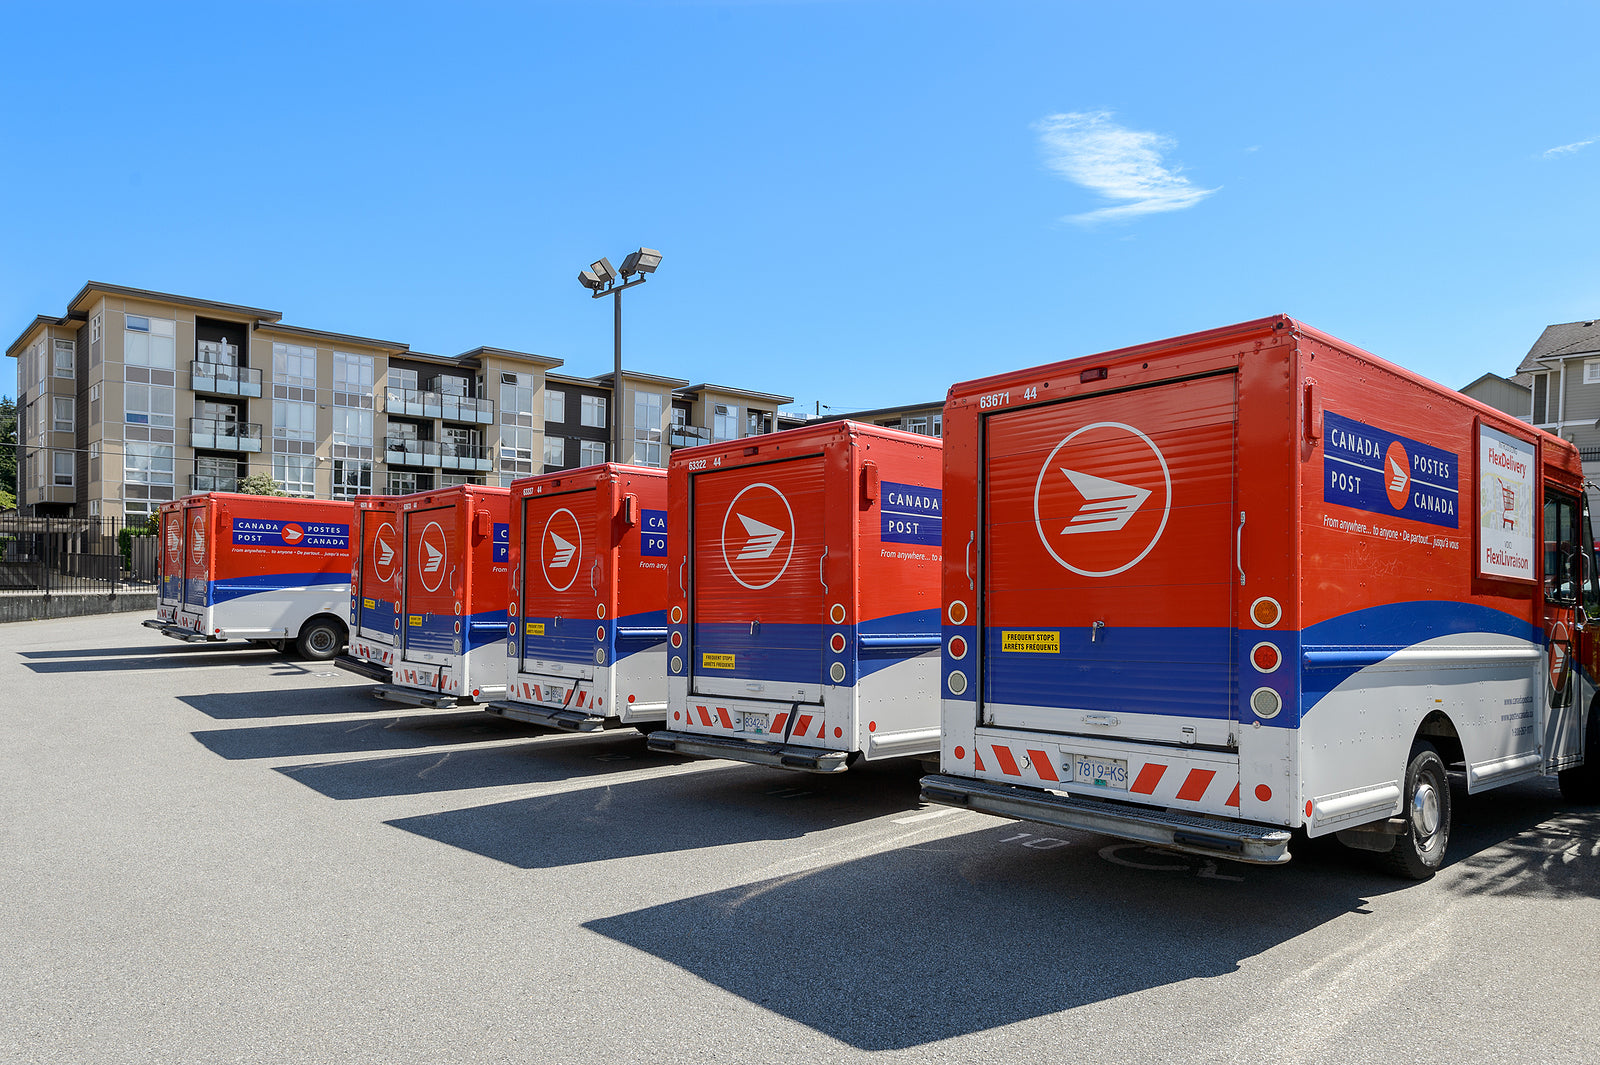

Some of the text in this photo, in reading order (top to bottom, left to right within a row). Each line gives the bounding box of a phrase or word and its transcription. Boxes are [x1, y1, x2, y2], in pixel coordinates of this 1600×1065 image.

[980, 386, 1037, 408] 63671 44
[1331, 428, 1381, 459] CANADA
[1414, 454, 1449, 479] POSTES
[1488, 447, 1527, 479] FlexDelivery
[1331, 471, 1361, 494] POST
[888, 492, 939, 510] CANADA
[1414, 492, 1454, 515] CANADA
[238, 522, 278, 530] CANADA
[307, 526, 341, 534] POSTES
[888, 520, 919, 535] POST
[1323, 514, 1339, 528] From
[1339, 519, 1372, 533] anywhere...
[1372, 525, 1380, 536] to
[1380, 528, 1399, 540] anyone
[1402, 530, 1410, 541] De
[1449, 540, 1460, 550] vous
[238, 534, 262, 542] POST
[307, 538, 344, 546] CANADA
[880, 549, 896, 558] From
[896, 551, 931, 561] anywhere...
[1486, 547, 1529, 570] FlexiLivraison
[1007, 633, 1055, 642] FREQUENT STOPS
[1077, 761, 1104, 779] 7819
[1110, 766, 1125, 782] KS
